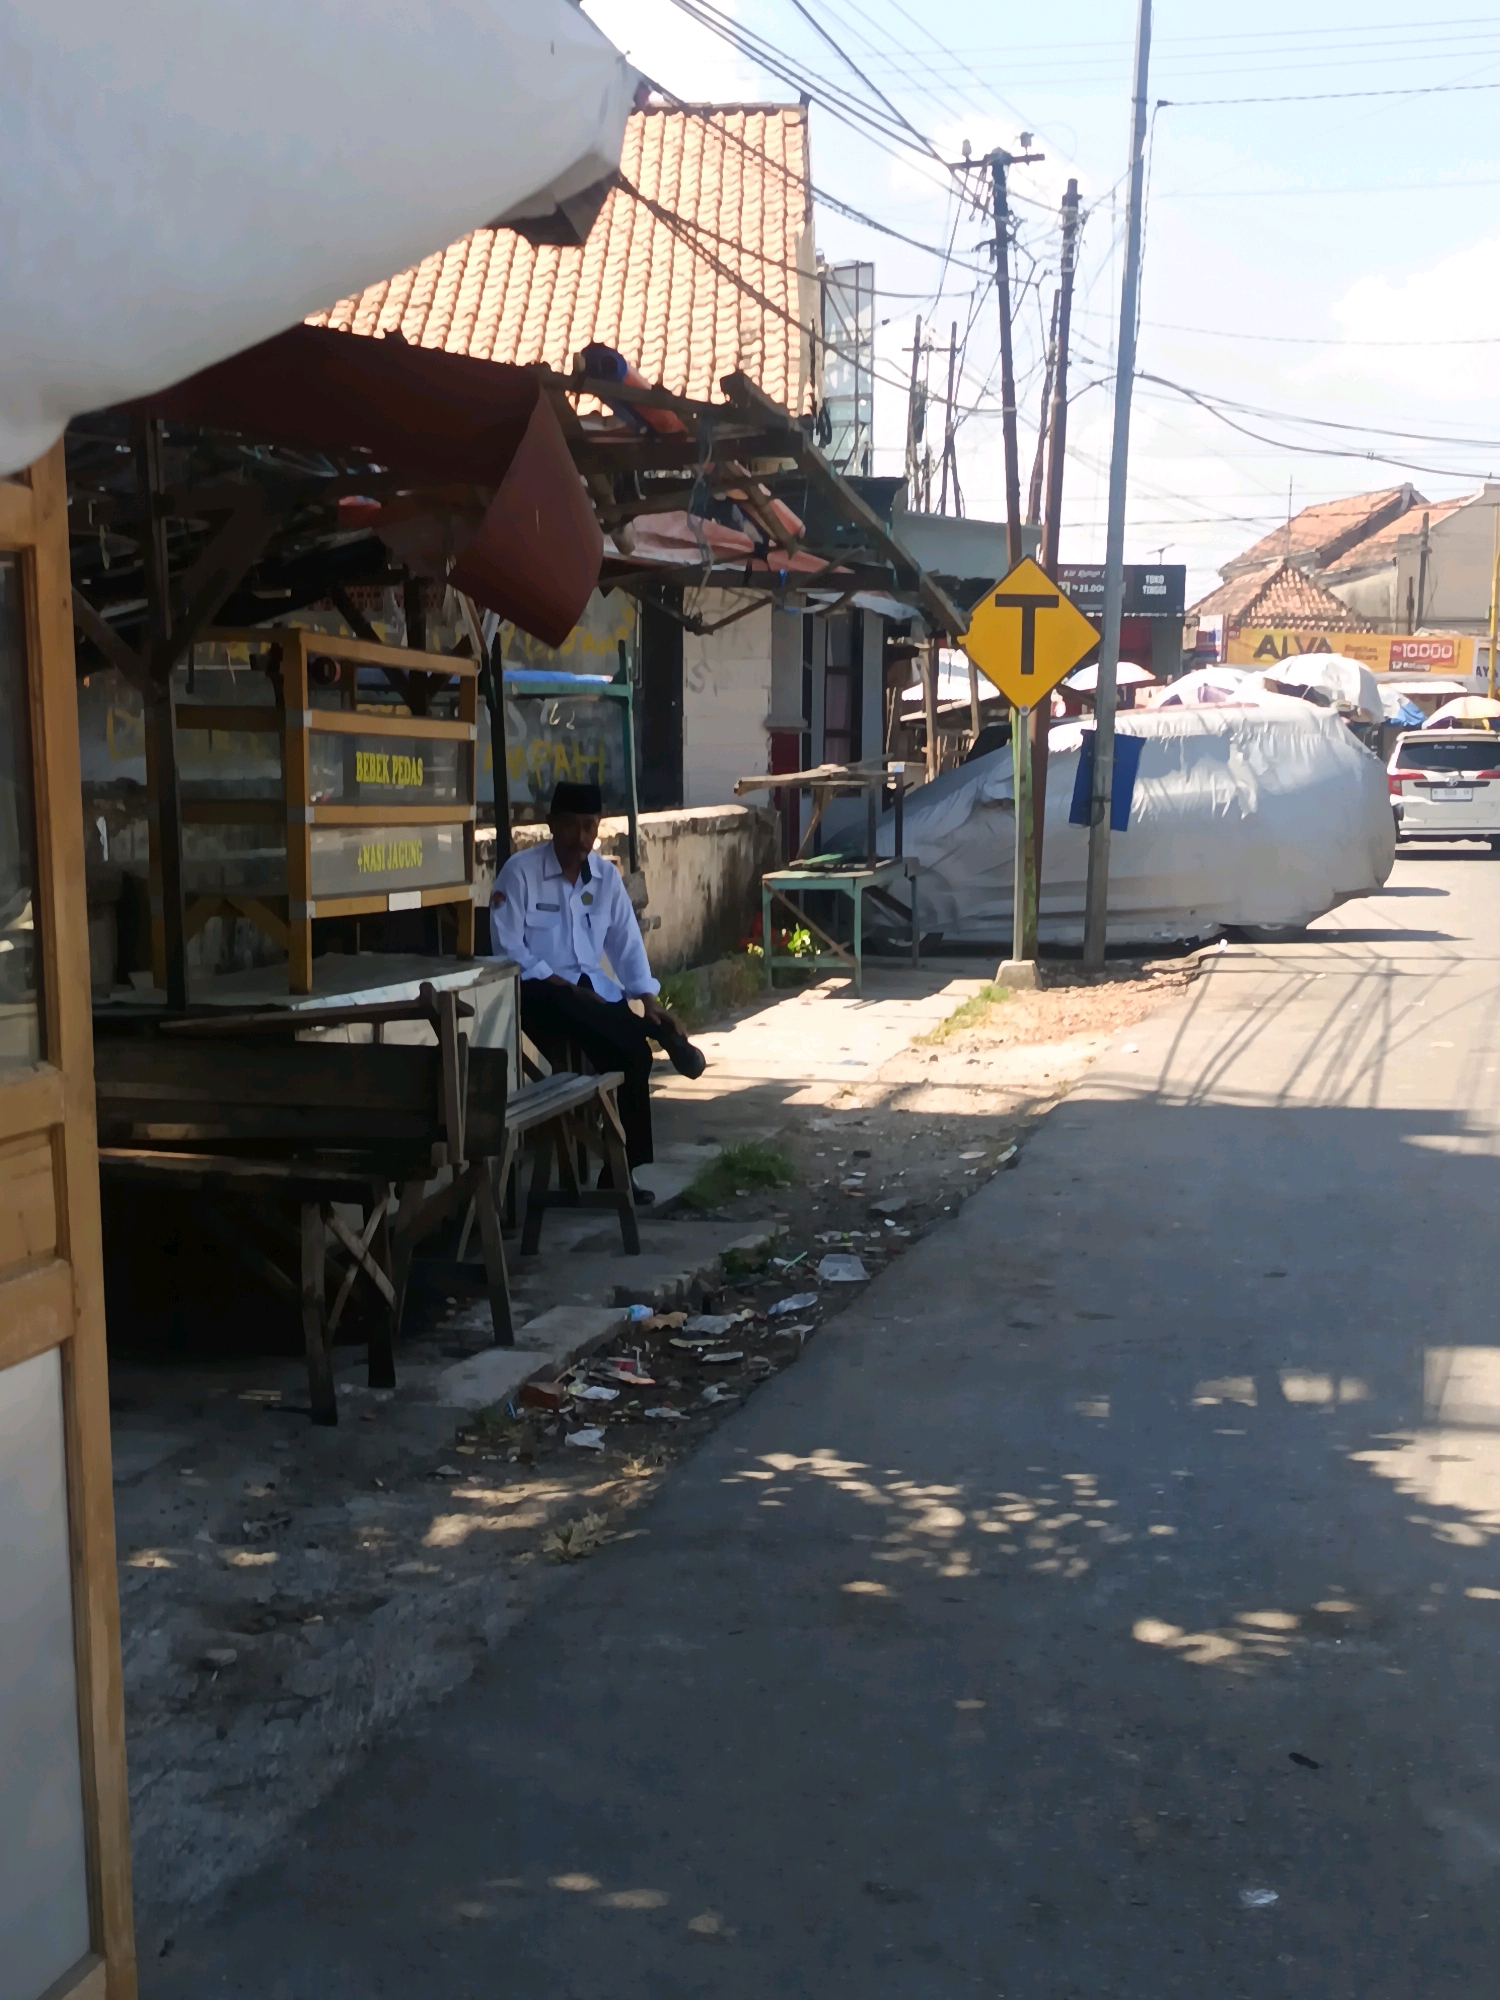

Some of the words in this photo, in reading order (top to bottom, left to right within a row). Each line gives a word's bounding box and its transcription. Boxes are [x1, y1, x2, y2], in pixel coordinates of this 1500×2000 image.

[356, 751, 389, 784] BEBEK
[392, 755, 423, 787] PEDAS
[387, 839, 423, 871] JAGUNG
